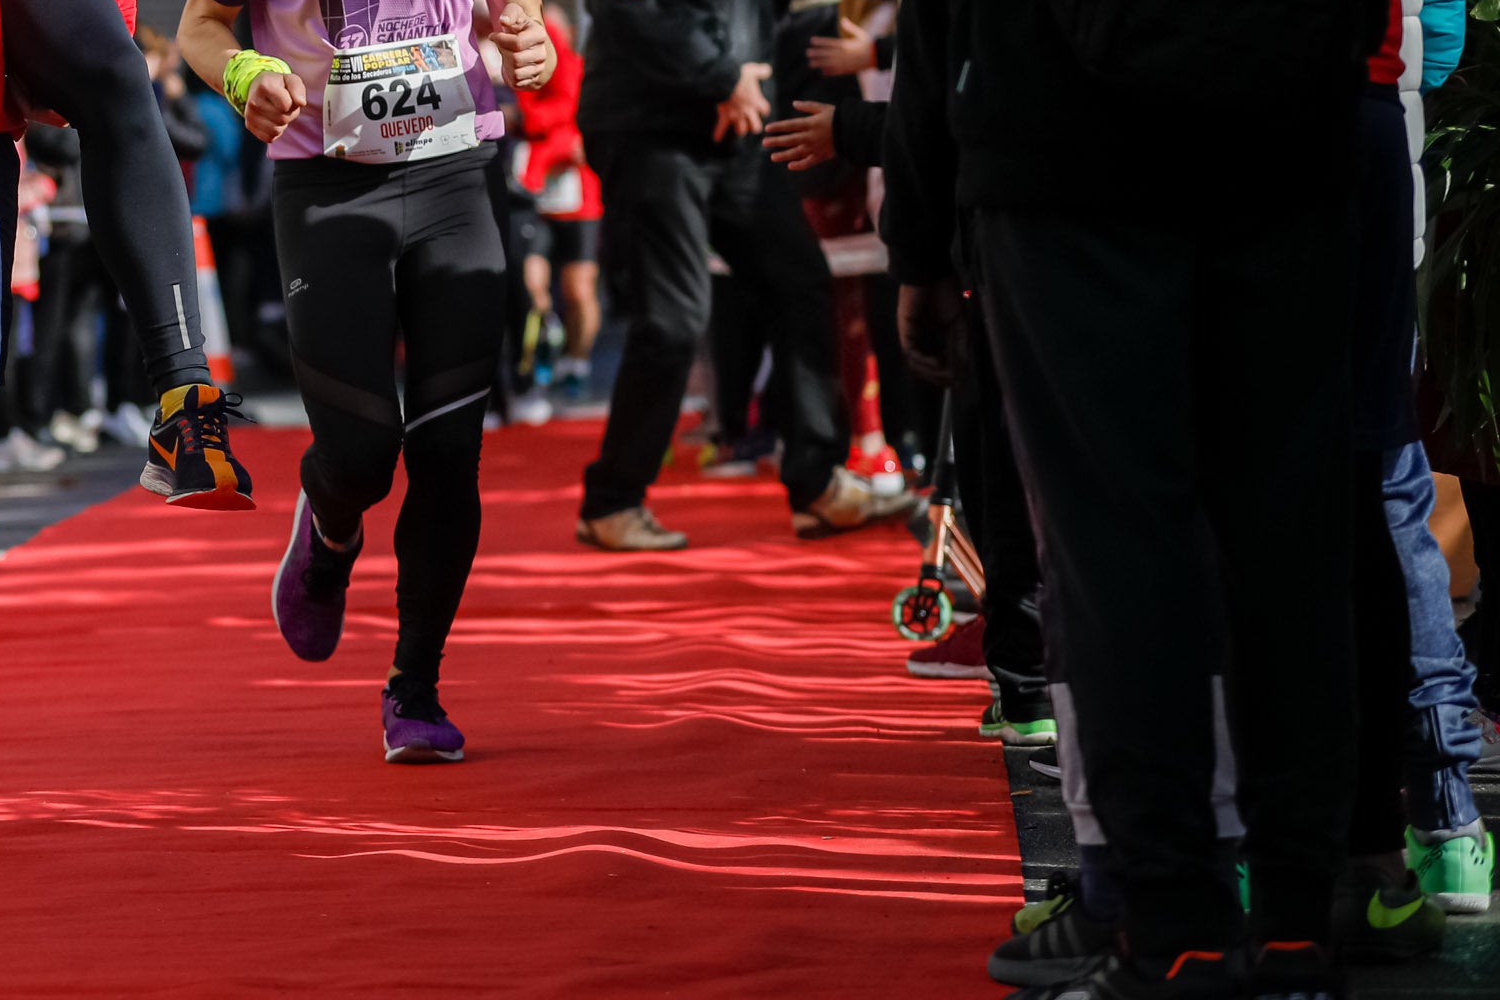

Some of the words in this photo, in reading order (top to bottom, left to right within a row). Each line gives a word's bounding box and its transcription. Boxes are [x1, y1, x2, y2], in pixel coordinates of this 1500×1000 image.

[340, 31, 364, 49] 37
[363, 49, 409, 63] CARRERA
[364, 57, 411, 71] POPULAR
[351, 71, 361, 80] los
[363, 68, 392, 79] Secaderos
[362, 75, 442, 121] 624
[380, 116, 434, 138] QUEVEDO
